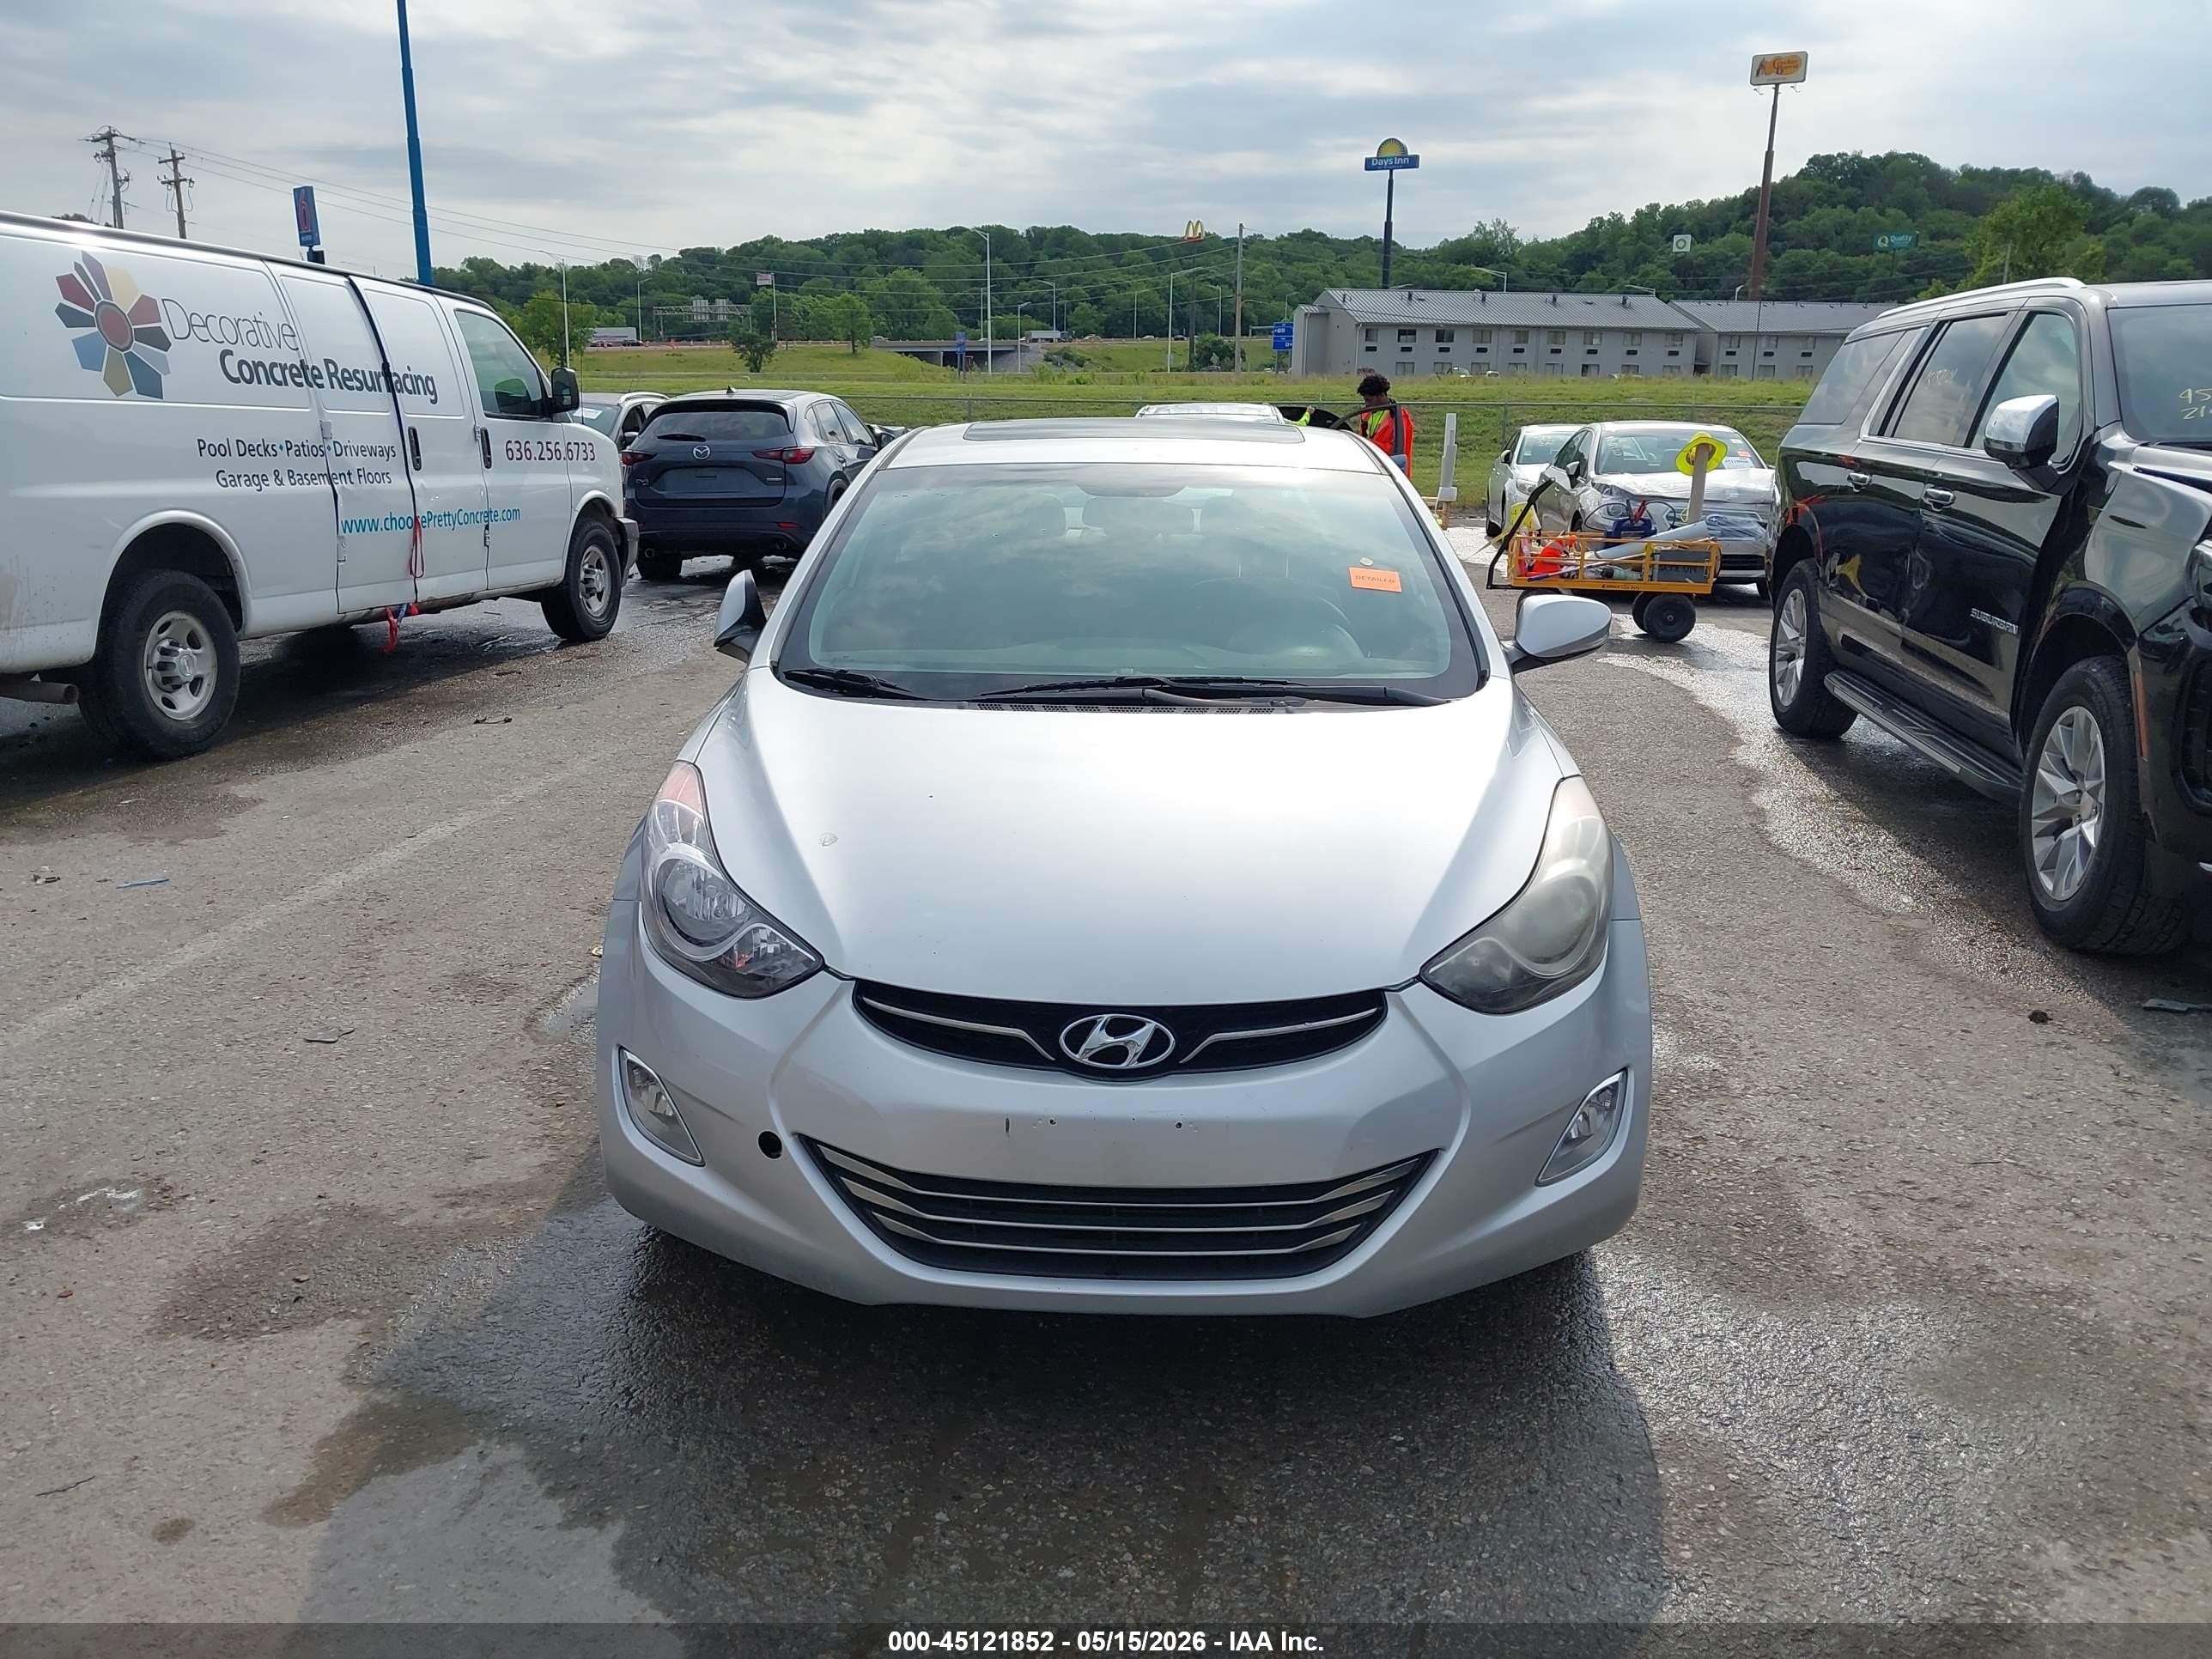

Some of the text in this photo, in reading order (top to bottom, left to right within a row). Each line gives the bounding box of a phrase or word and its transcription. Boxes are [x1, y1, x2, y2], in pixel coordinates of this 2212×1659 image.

[161, 299, 299, 350] Decorative
[220, 349, 324, 388] Concrete
[198, 438, 397, 461] Pool Decks Patios Driveways
[506, 440, 596, 461] 636.256.6733
[216, 467, 392, 491] Garage & Basement Floors
[341, 507, 520, 534] www.chooePrettyConcrete.com
